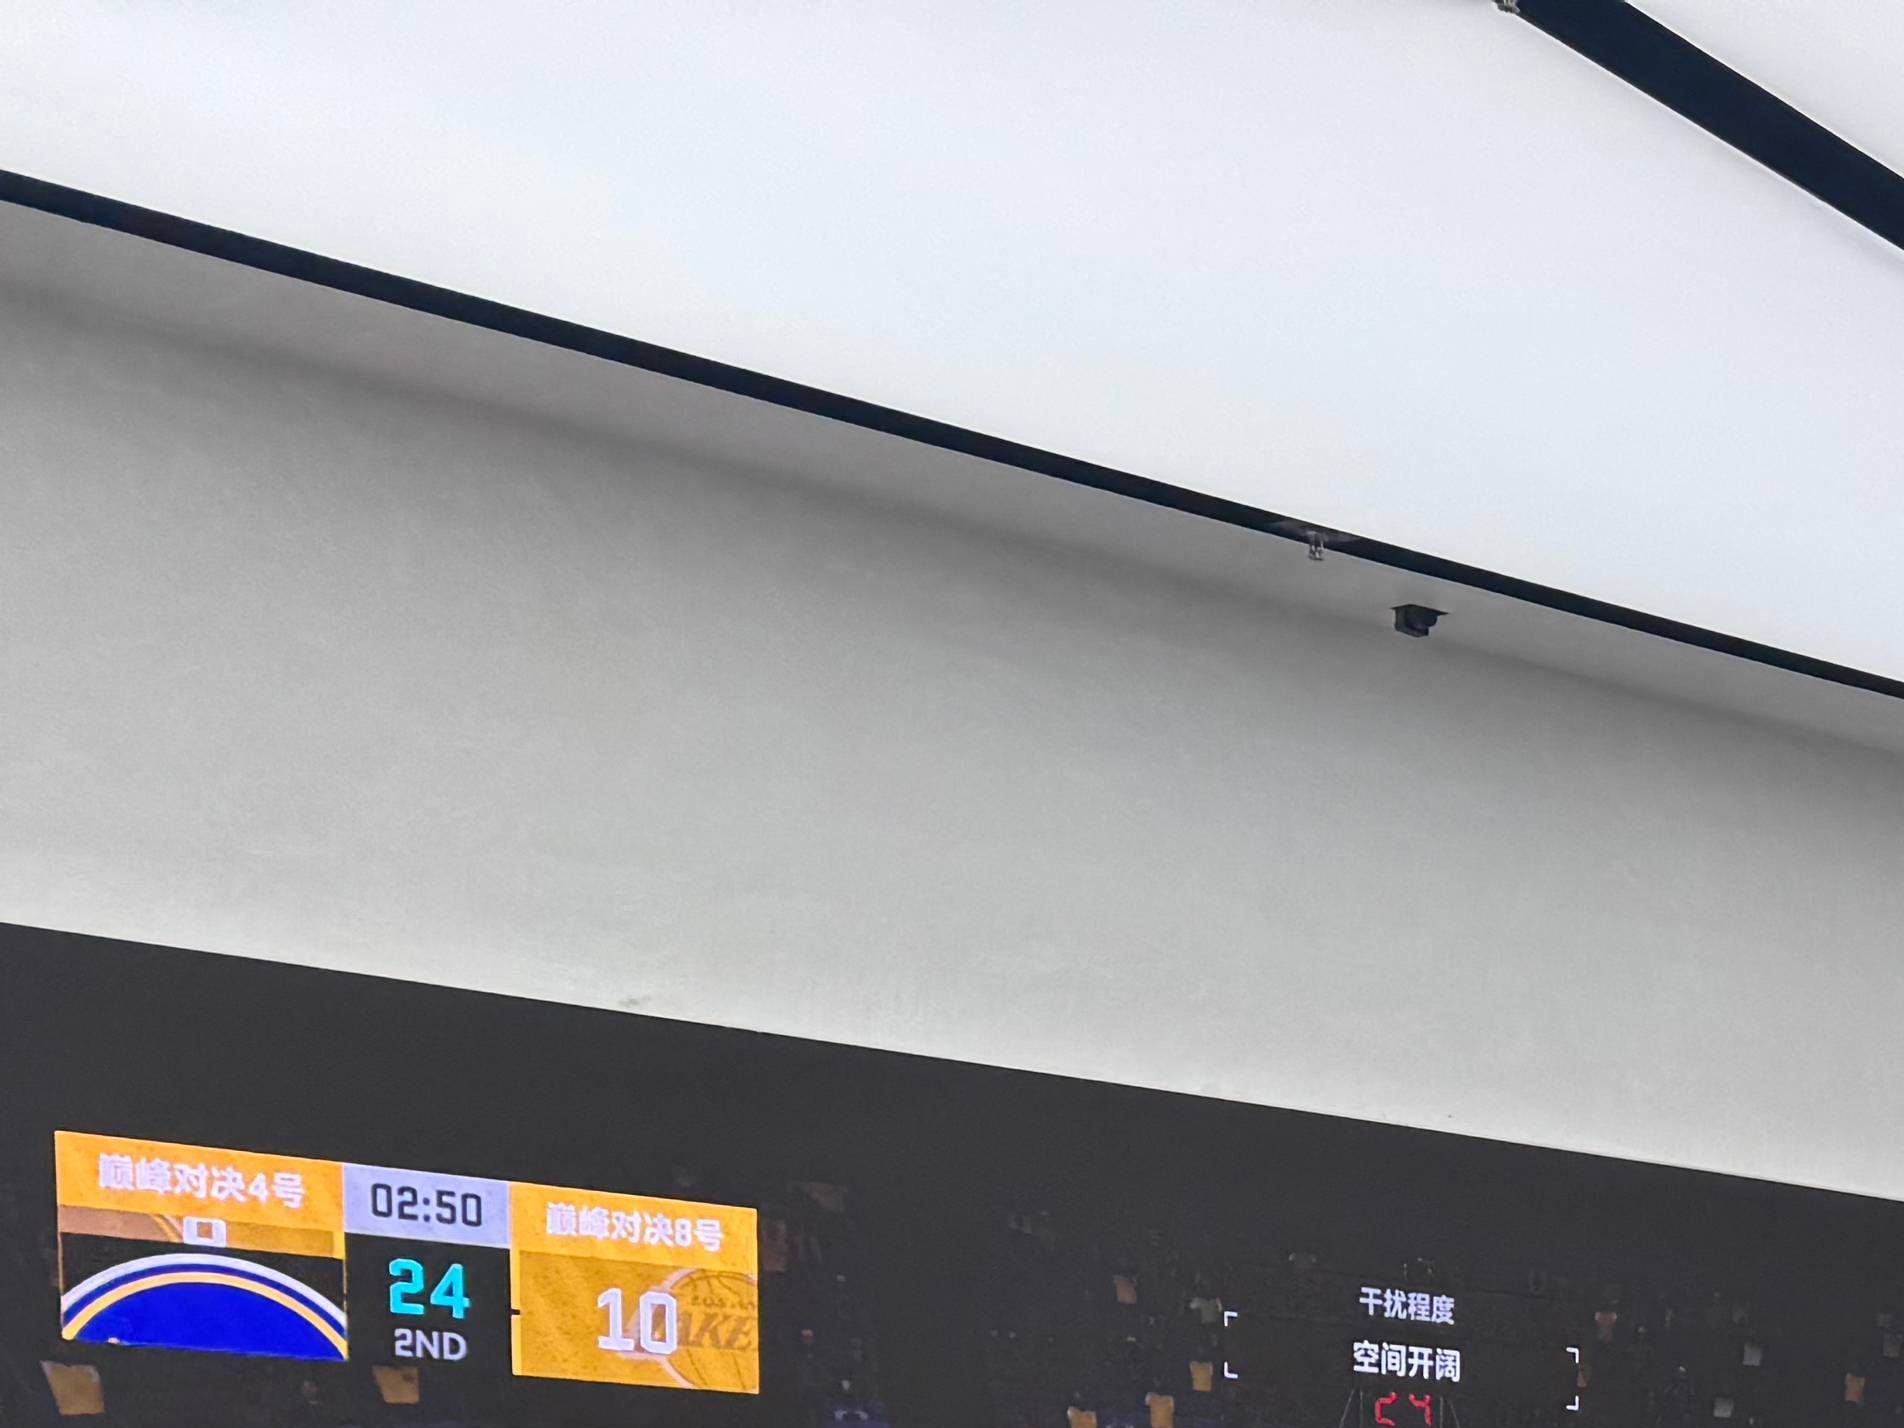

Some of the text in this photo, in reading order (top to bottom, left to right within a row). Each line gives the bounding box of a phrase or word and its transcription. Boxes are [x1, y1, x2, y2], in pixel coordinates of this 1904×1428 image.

[98, 1153, 304, 1209] 巅峰对决4号
[371, 1183, 482, 1227] 02:50
[546, 1203, 724, 1253] 巅峰对决8号
[389, 1258, 471, 1319] 24
[1359, 1286, 1455, 1325] 干扰程度
[394, 1328, 467, 1361] 2ND
[597, 1288, 678, 1354] 10
[1352, 1340, 1461, 1382] 空间开阔
